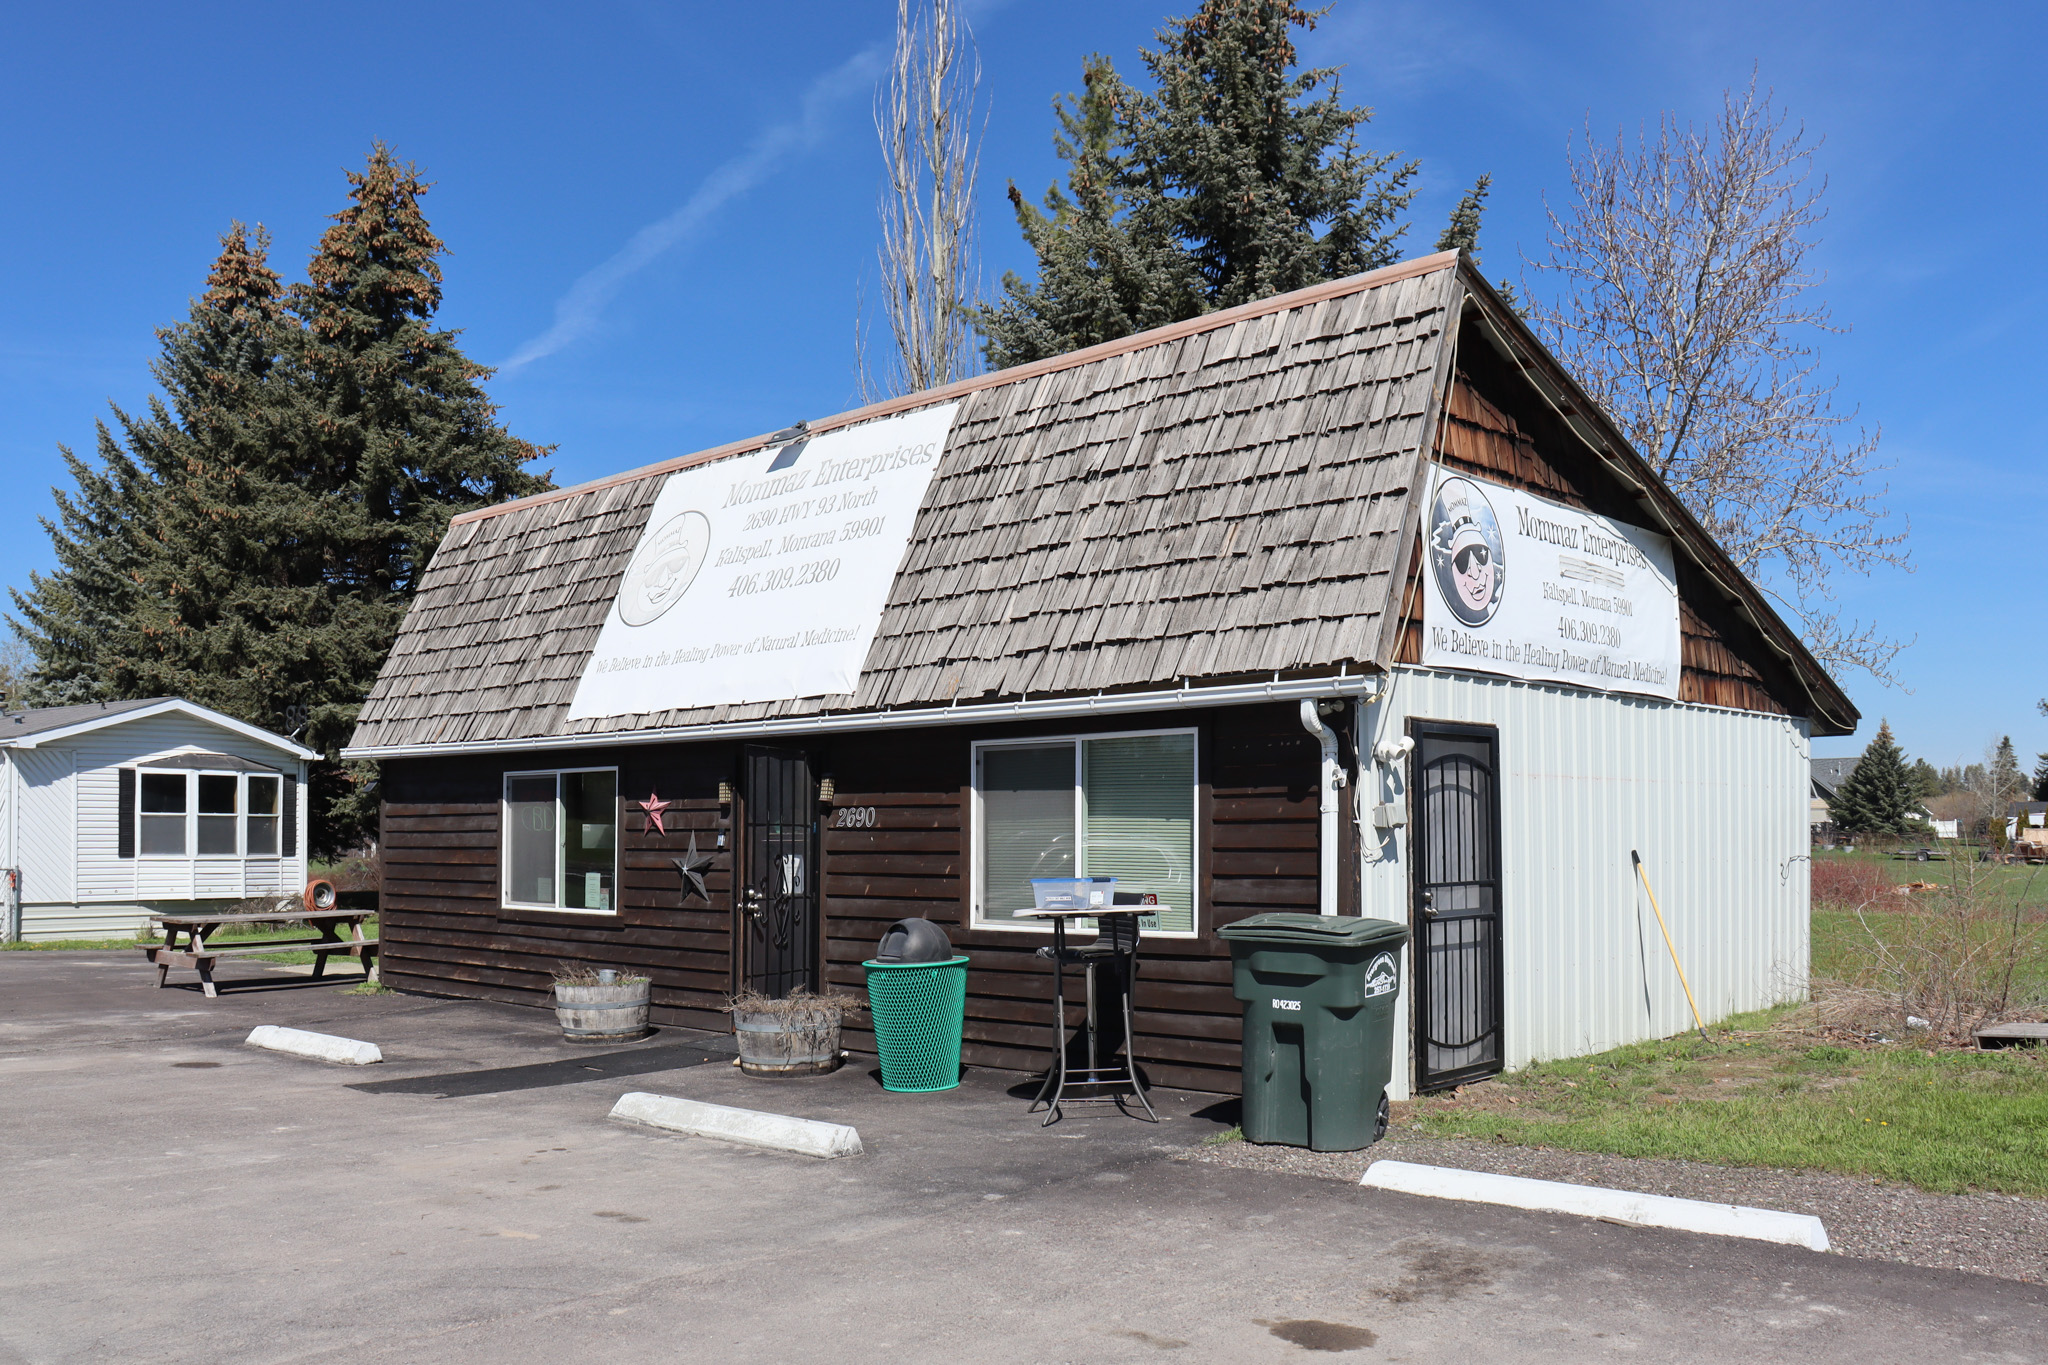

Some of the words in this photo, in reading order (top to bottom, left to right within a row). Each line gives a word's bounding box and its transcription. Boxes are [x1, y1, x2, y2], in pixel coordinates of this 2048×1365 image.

[721, 469, 811, 509] Mommaz
[811, 442, 937, 487] Enterprises
[743, 508, 777, 531] 2690
[778, 500, 814, 525] HWY
[815, 494, 836, 516] 93
[836, 486, 878, 512] North
[714, 539, 772, 567] Kalispell,
[777, 530, 836, 555] Montana
[839, 515, 886, 542] 59901
[1516, 505, 1578, 549] Mommaz
[1581, 525, 1647, 569] Enterprises
[728, 558, 841, 597] 406.309.2380
[1543, 582, 1579, 607] Kalispell,
[1581, 590, 1612, 612] Montana
[1613, 597, 1633, 617] 59901
[596, 659, 608, 674] We
[608, 655, 641, 672] Believe
[642, 655, 652, 668] in
[655, 651, 671, 666] the
[671, 648, 710, 664] Healing
[711, 643, 742, 659] Power
[744, 638, 760, 653] of
[757, 632, 800, 653] Natural
[800, 624, 861, 647] Medicine!
[1558, 617, 1621, 648] 406.309.2380
[1432, 627, 1448, 651] We
[1451, 630, 1489, 658] Believe
[1492, 640, 1502, 660] in
[1505, 639, 1521, 662] the
[1523, 644, 1560, 672] Healing
[1562, 649, 1588, 673] Power
[1590, 655, 1602, 674] of
[1601, 656, 1631, 680] Natural
[1633, 662, 1668, 685] Medicine!
[522, 806, 555, 831] CBD
[836, 807, 876, 828] 2690
